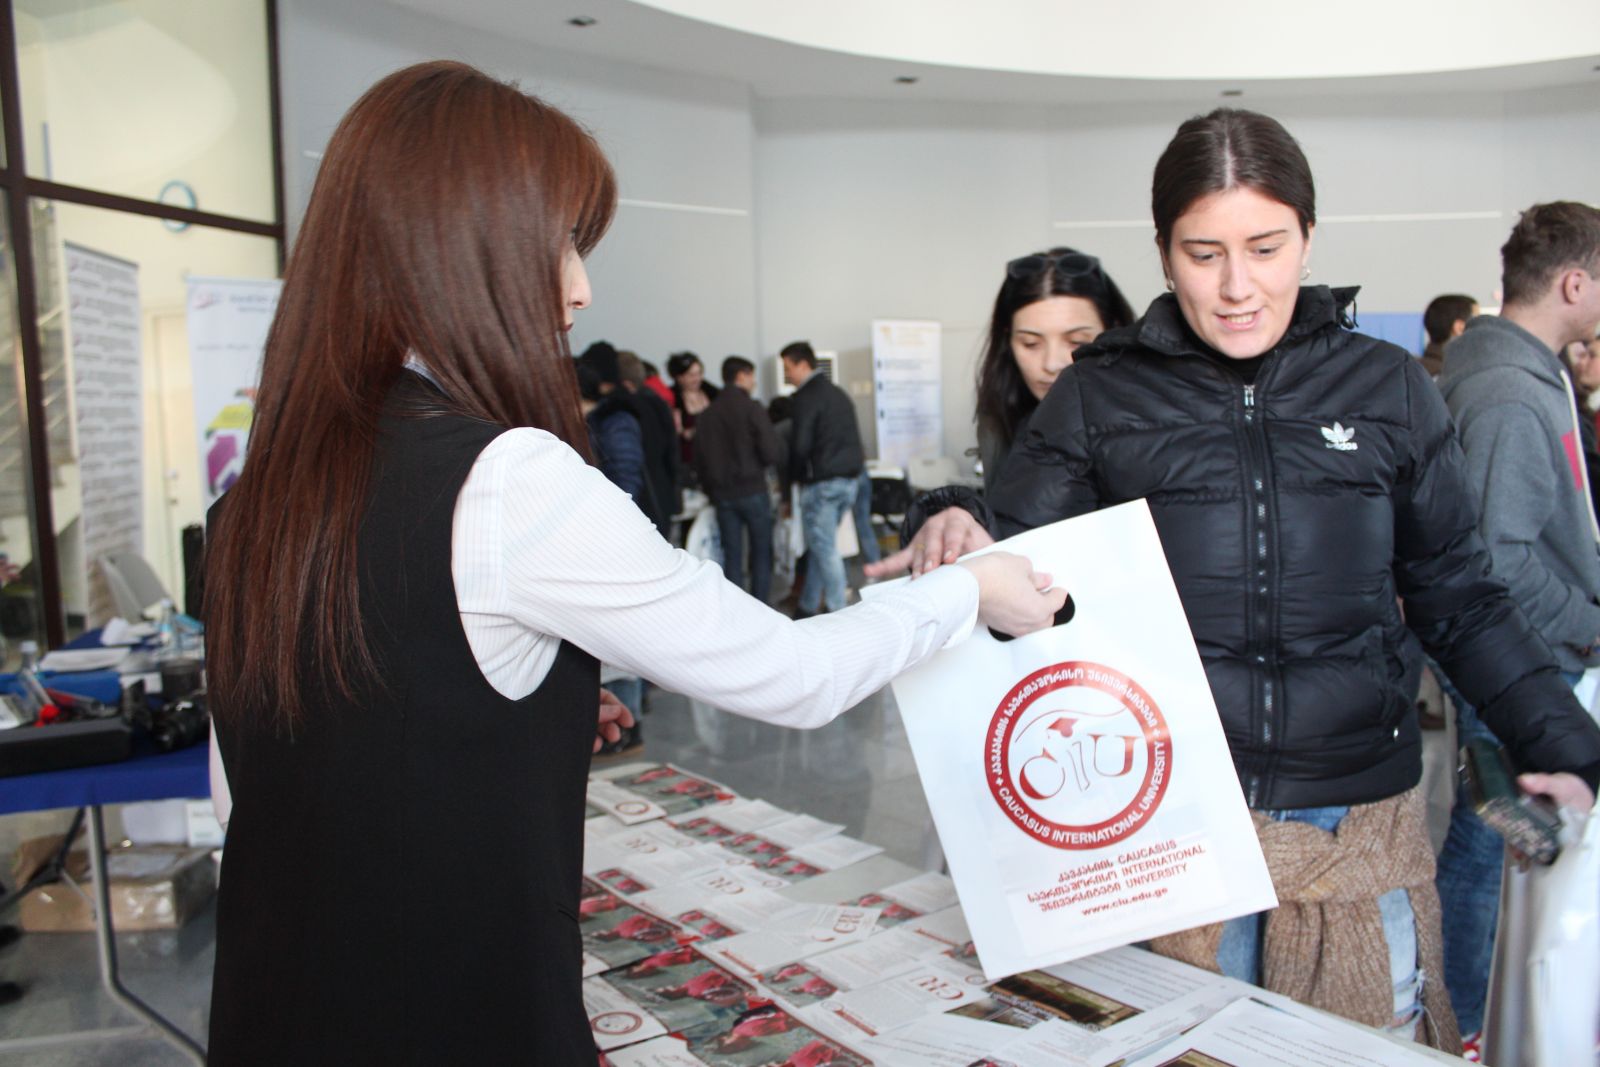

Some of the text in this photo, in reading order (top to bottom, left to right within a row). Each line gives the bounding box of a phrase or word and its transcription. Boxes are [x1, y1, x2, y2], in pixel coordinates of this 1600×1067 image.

[998, 741, 1166, 844] CAUCASUS INTERNATIONAL UNIVERSITY
[1118, 839, 1177, 864] CAUCASUS
[1122, 844, 1206, 877] INTERNATIONAL
[1126, 863, 1188, 888] UNIVERSITY
[1081, 886, 1168, 916] www.ciu.edu.ge
